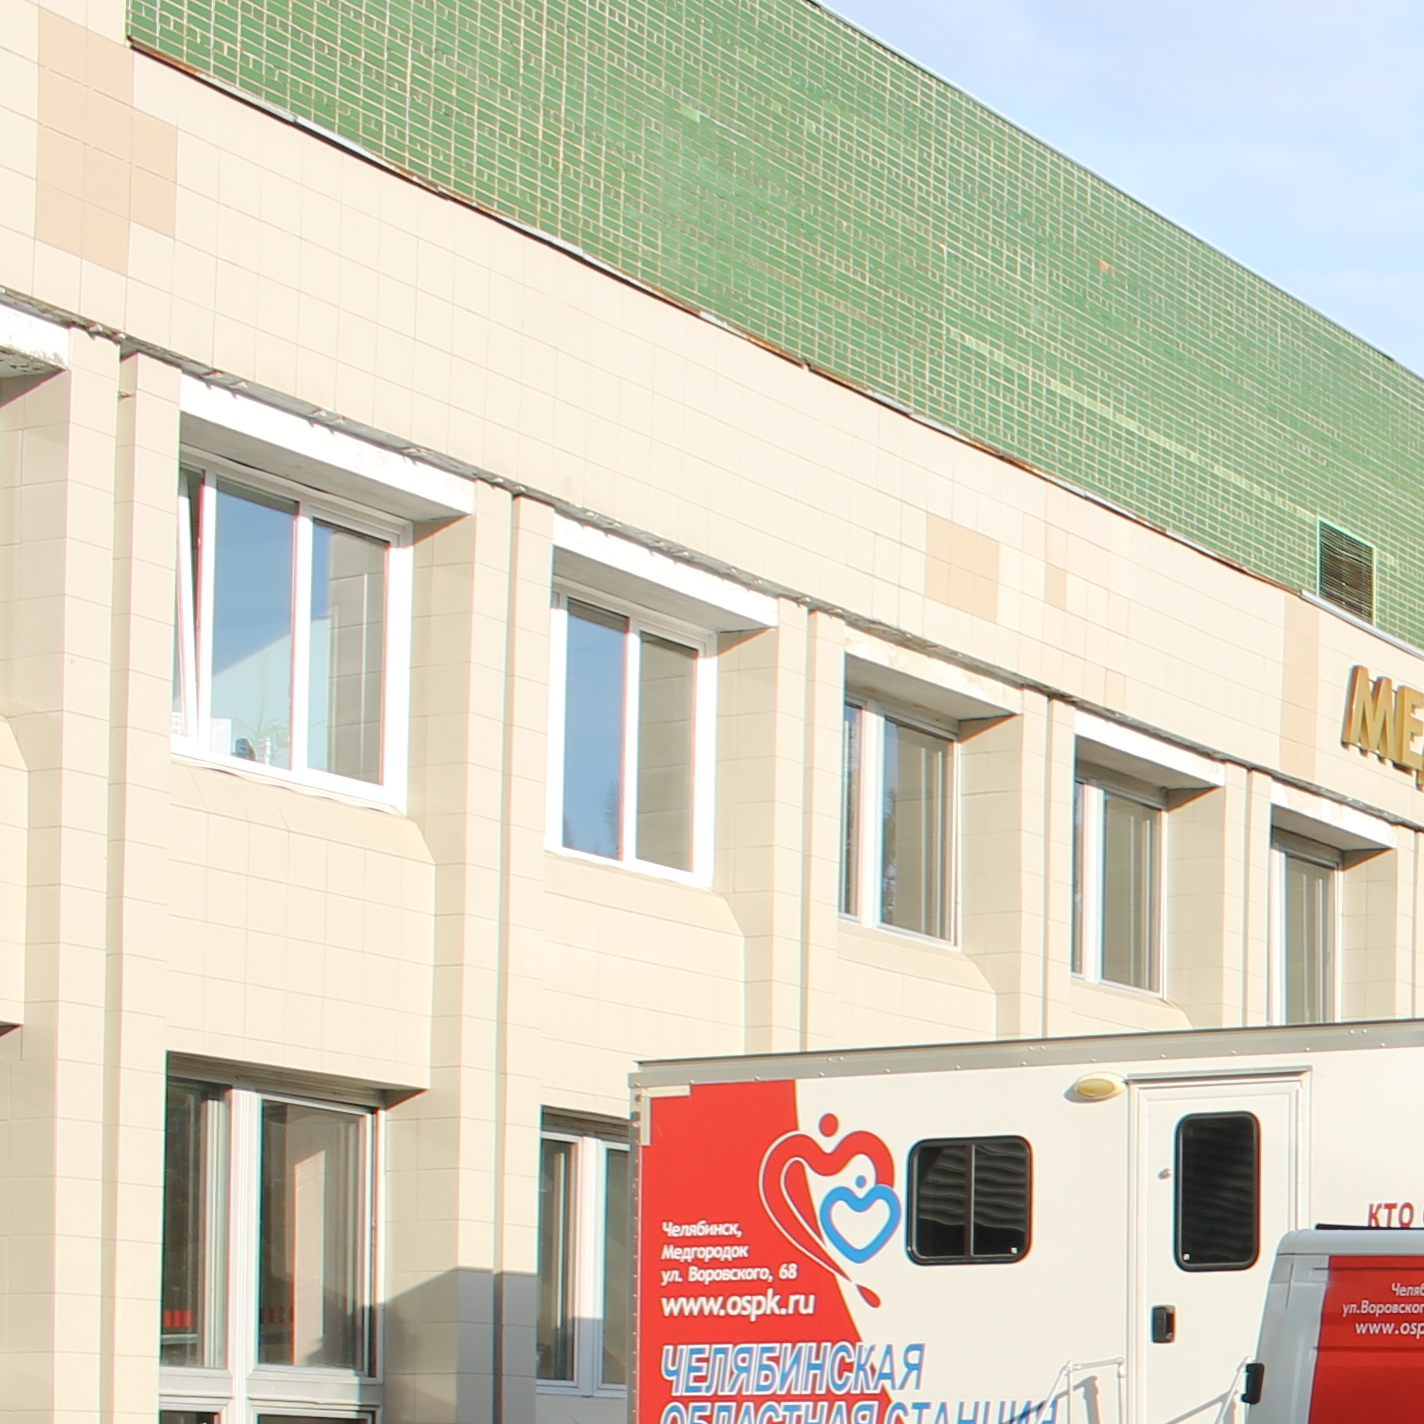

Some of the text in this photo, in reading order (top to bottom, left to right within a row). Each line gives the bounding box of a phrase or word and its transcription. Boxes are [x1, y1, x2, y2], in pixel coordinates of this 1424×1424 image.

[1367, 1202, 1415, 1228] КТО
[661, 1220, 743, 1238] Челябинск,
[661, 1245, 749, 1262] Медгородок
[660, 1263, 798, 1286] ул. Воровского, 68
[660, 1288, 816, 1322] www.ospk.ru
[661, 1342, 926, 1396] ЧЕЛЯБИНСКАЯ
